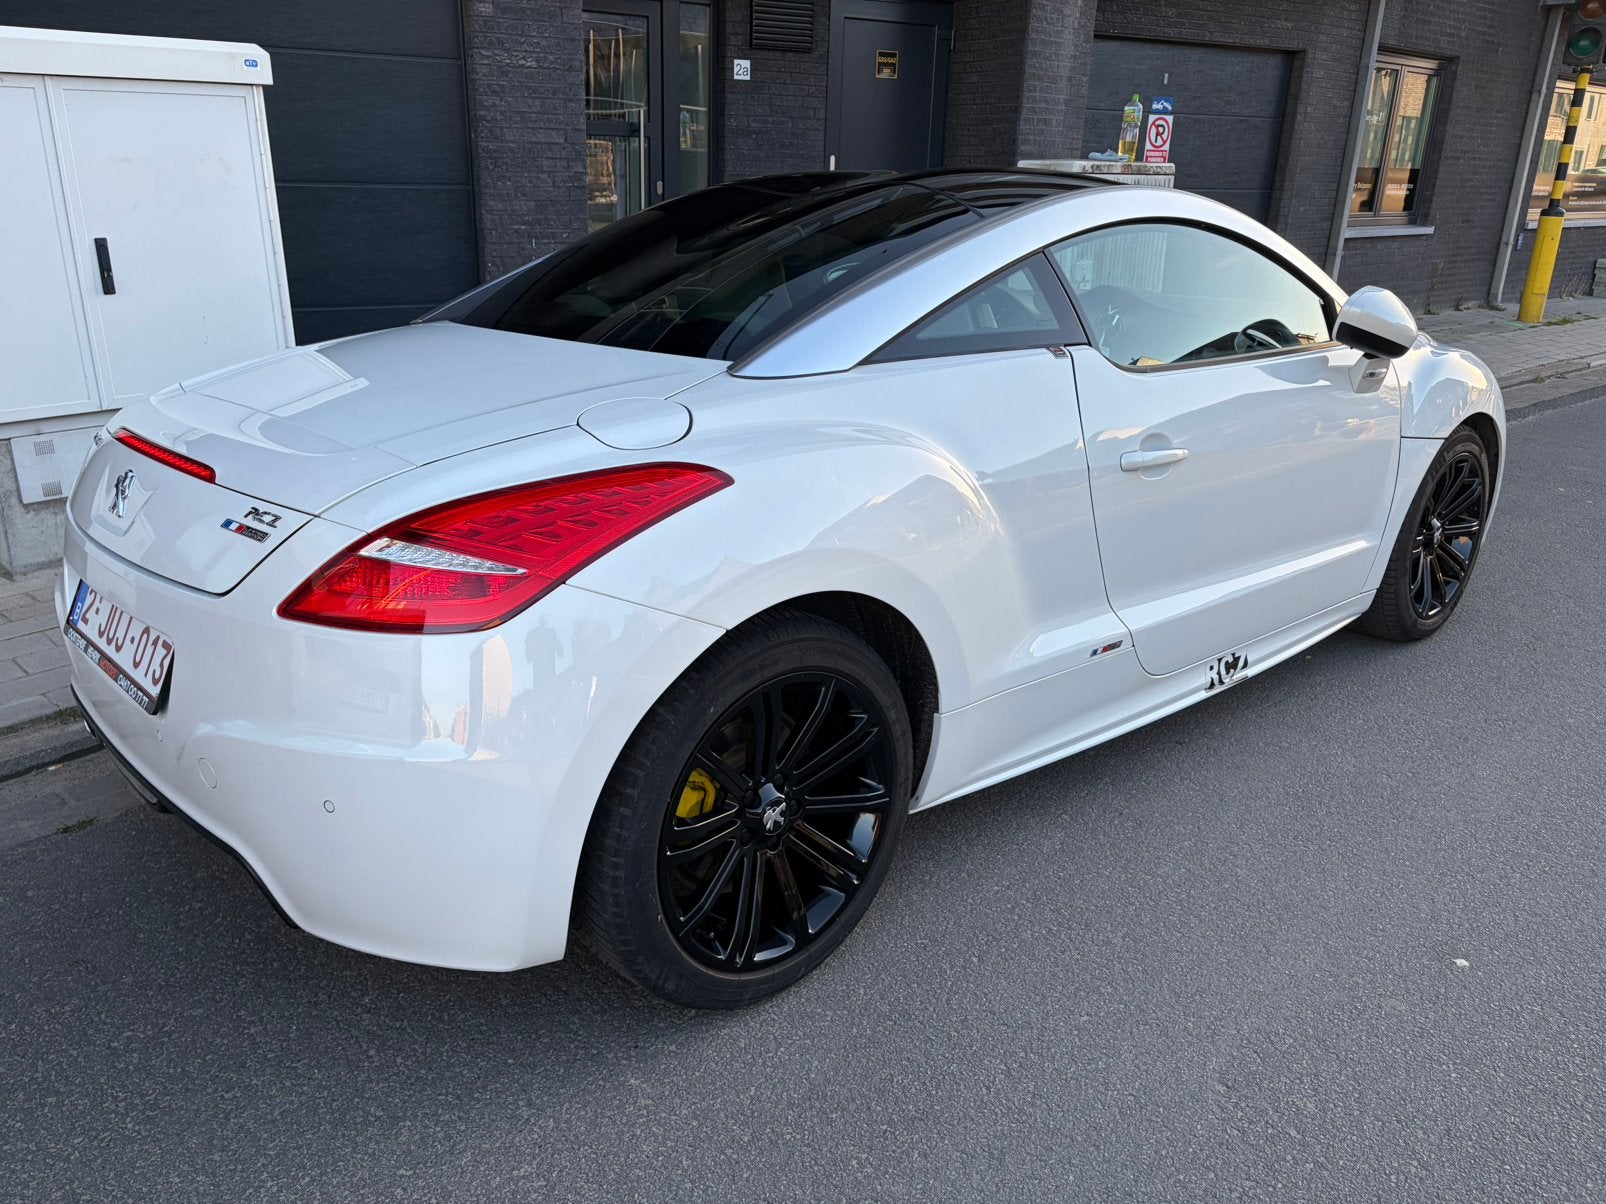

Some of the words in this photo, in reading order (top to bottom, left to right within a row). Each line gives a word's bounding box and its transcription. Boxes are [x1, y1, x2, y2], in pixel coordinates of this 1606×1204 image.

[735, 63, 748, 76] 2a
[244, 506, 282, 528] RCZ
[74, 602, 82, 620] B
[1205, 650, 1248, 690] RCZ
